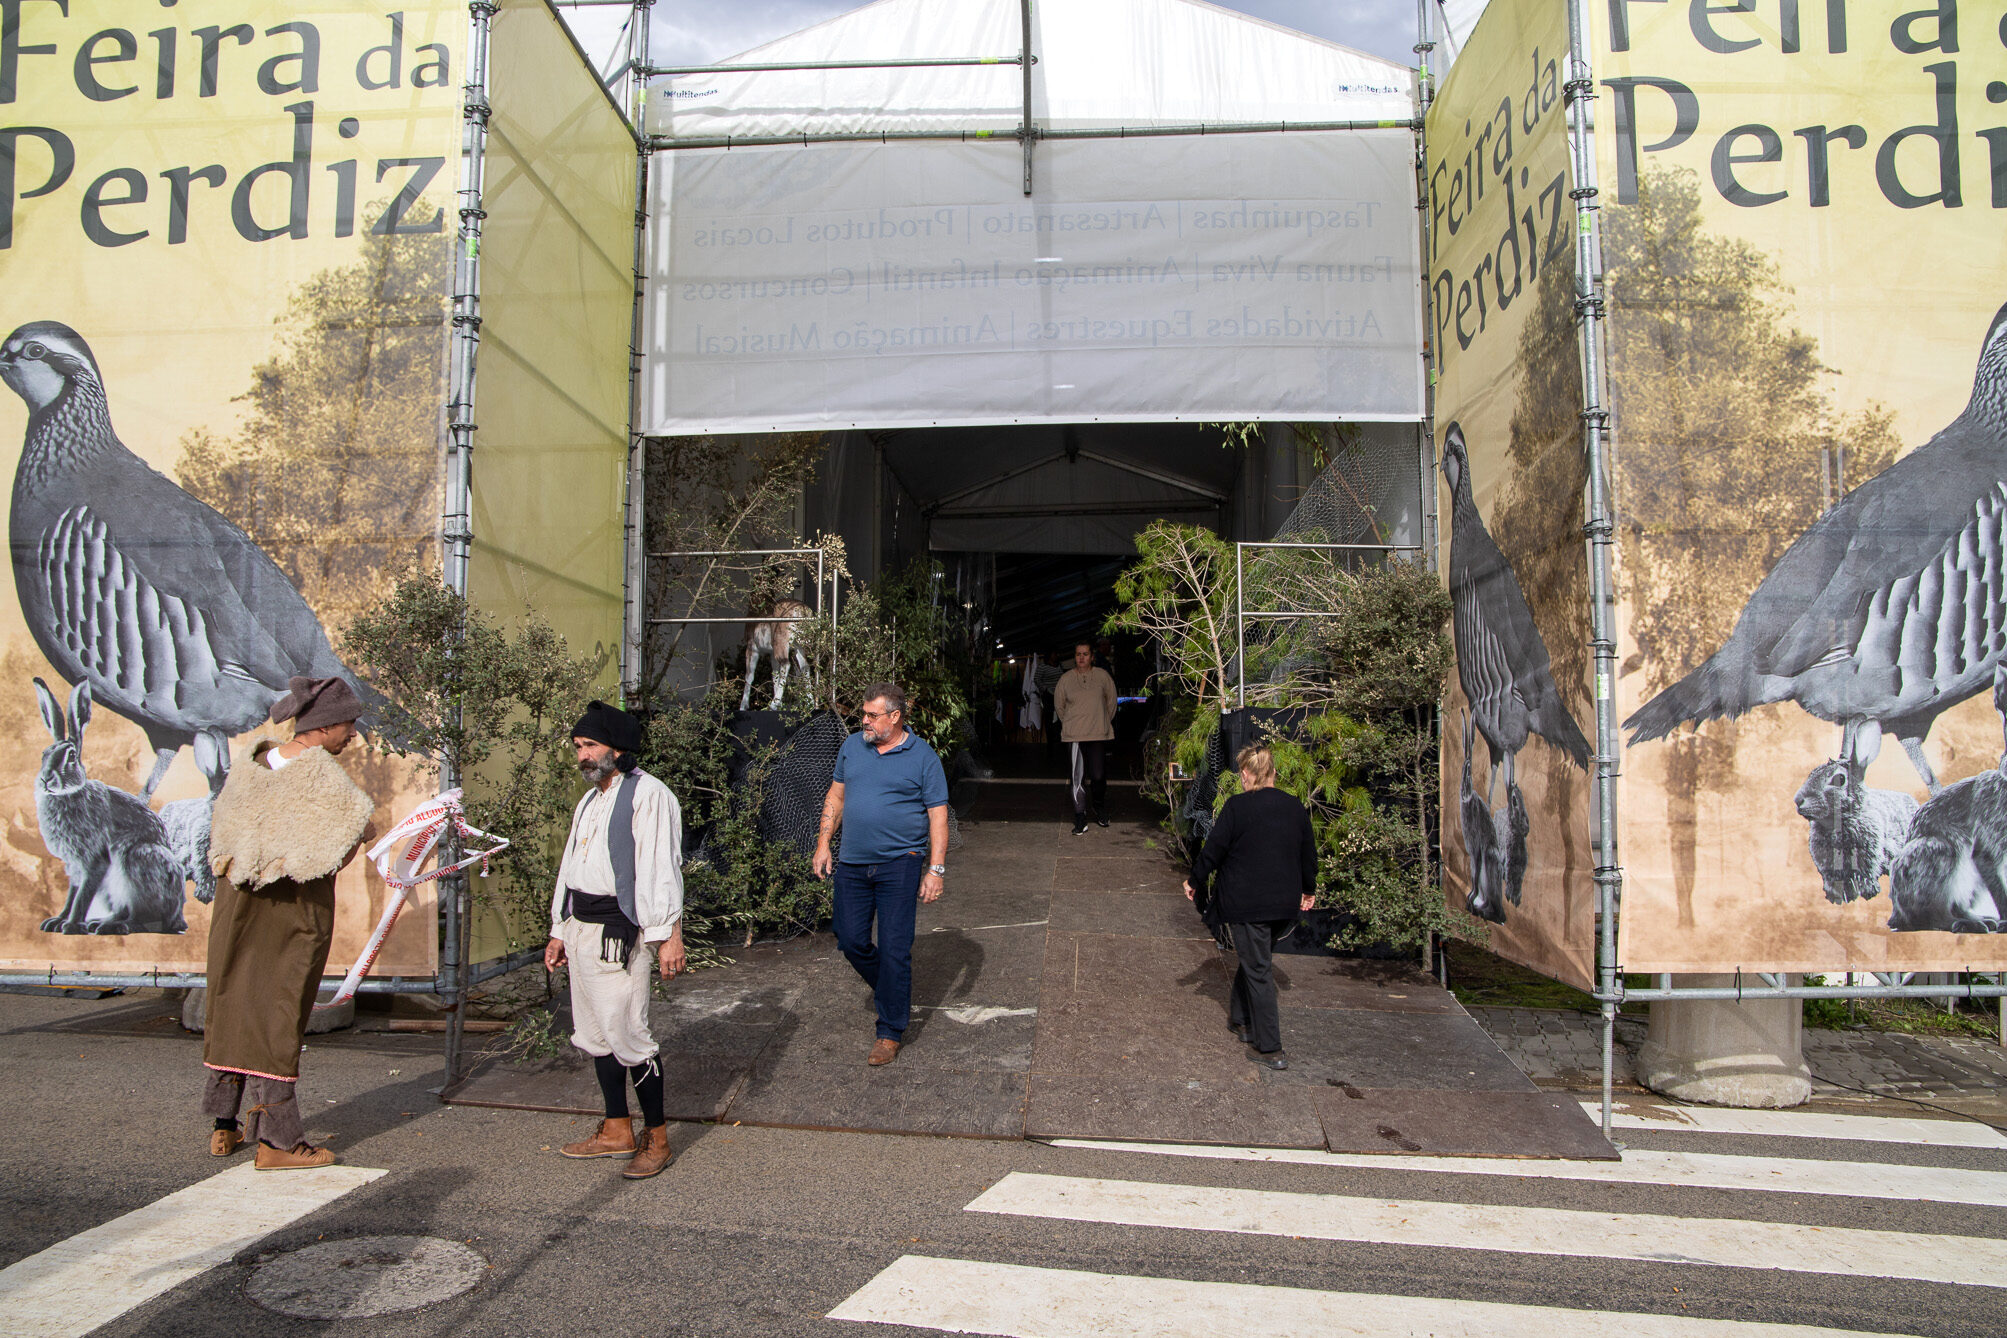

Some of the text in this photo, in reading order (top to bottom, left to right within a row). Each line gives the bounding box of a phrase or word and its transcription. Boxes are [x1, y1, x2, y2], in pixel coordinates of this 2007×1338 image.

[356, 12, 450, 90] da
[0, 100, 447, 250] Perdiz
[1430, 46, 1557, 264] Feira da
[1432, 166, 1569, 377] Perdiz
